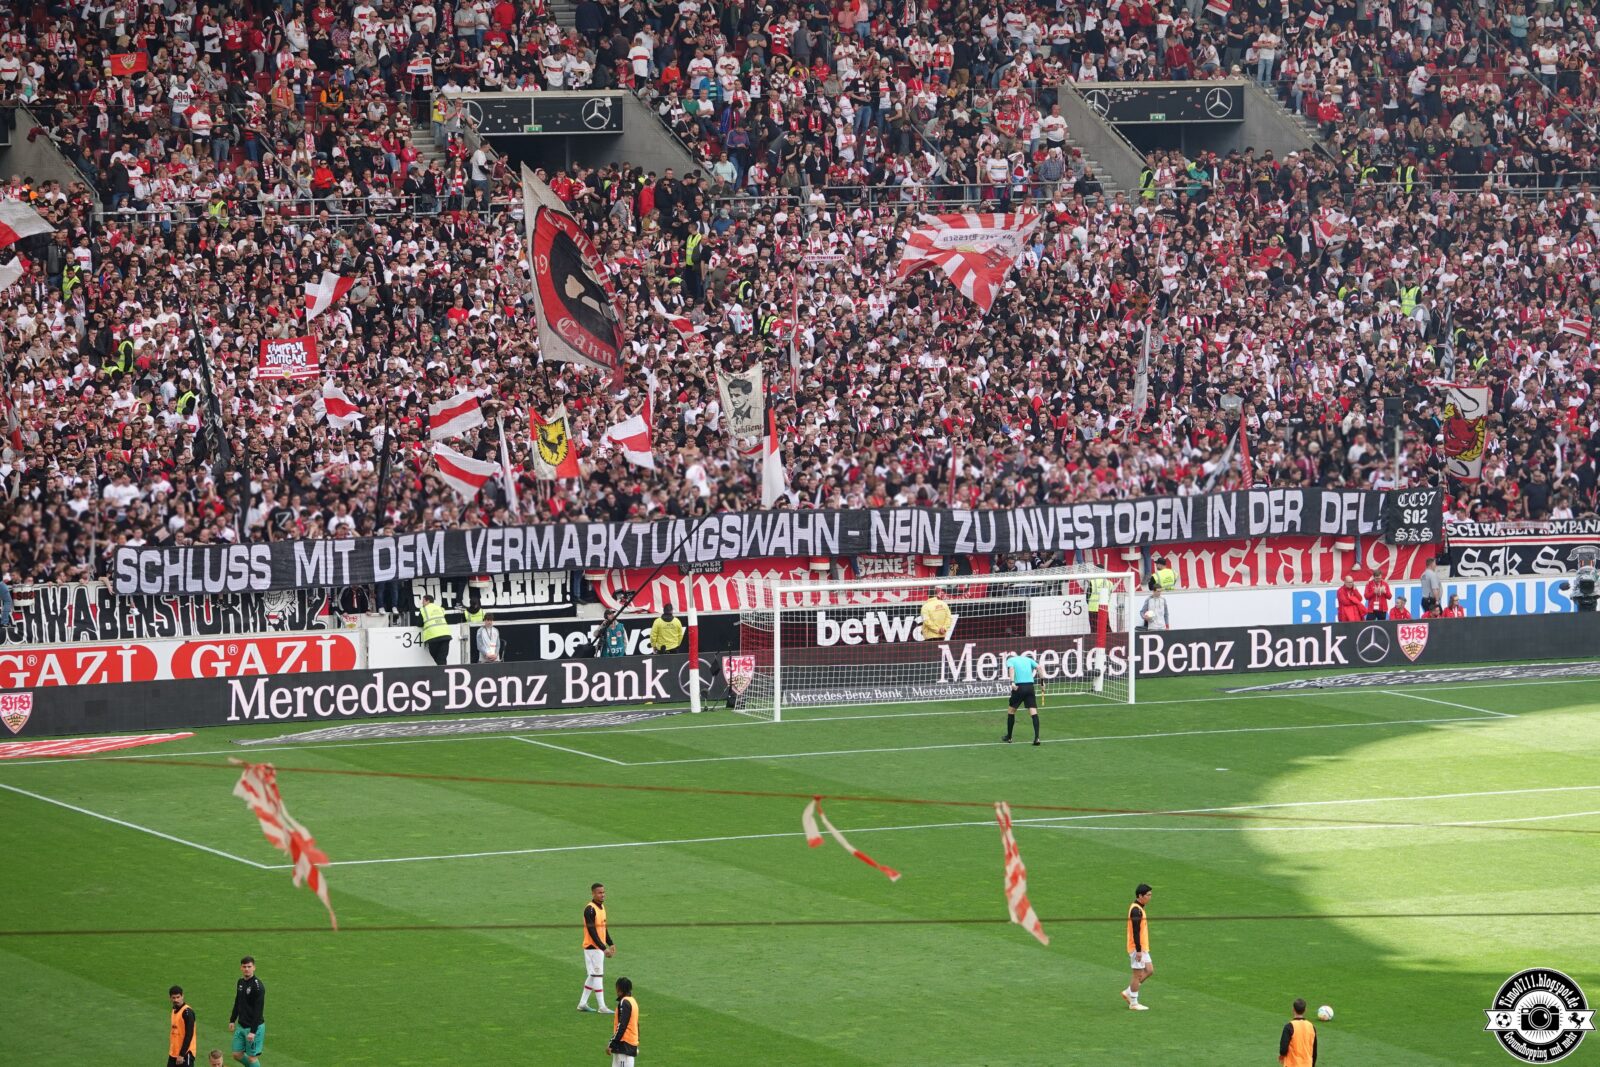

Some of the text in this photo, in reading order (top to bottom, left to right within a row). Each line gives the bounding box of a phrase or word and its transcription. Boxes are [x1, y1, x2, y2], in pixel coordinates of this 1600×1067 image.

[115, 545, 271, 594] SCHLUSS
[294, 539, 356, 587] MIT
[373, 531, 446, 582] DEM
[466, 512, 841, 573] VERMARKTUNGSWAHN
[871, 508, 941, 554] NEIN
[952, 510, 996, 553] ZU
[1009, 497, 1193, 552] INVESTOREN
[1206, 492, 1238, 538] IN
[1248, 488, 1303, 537] DER
[1320, 490, 1386, 534] DFL!
[856, 556, 903, 577] SZENE
[1062, 600, 1083, 616] 35
[402, 632, 423, 648] 34
[937, 633, 1235, 684] Meredes-Benz
[1247, 626, 1348, 668] Bank
[227, 659, 671, 722] Mercedes-Benz Bank
